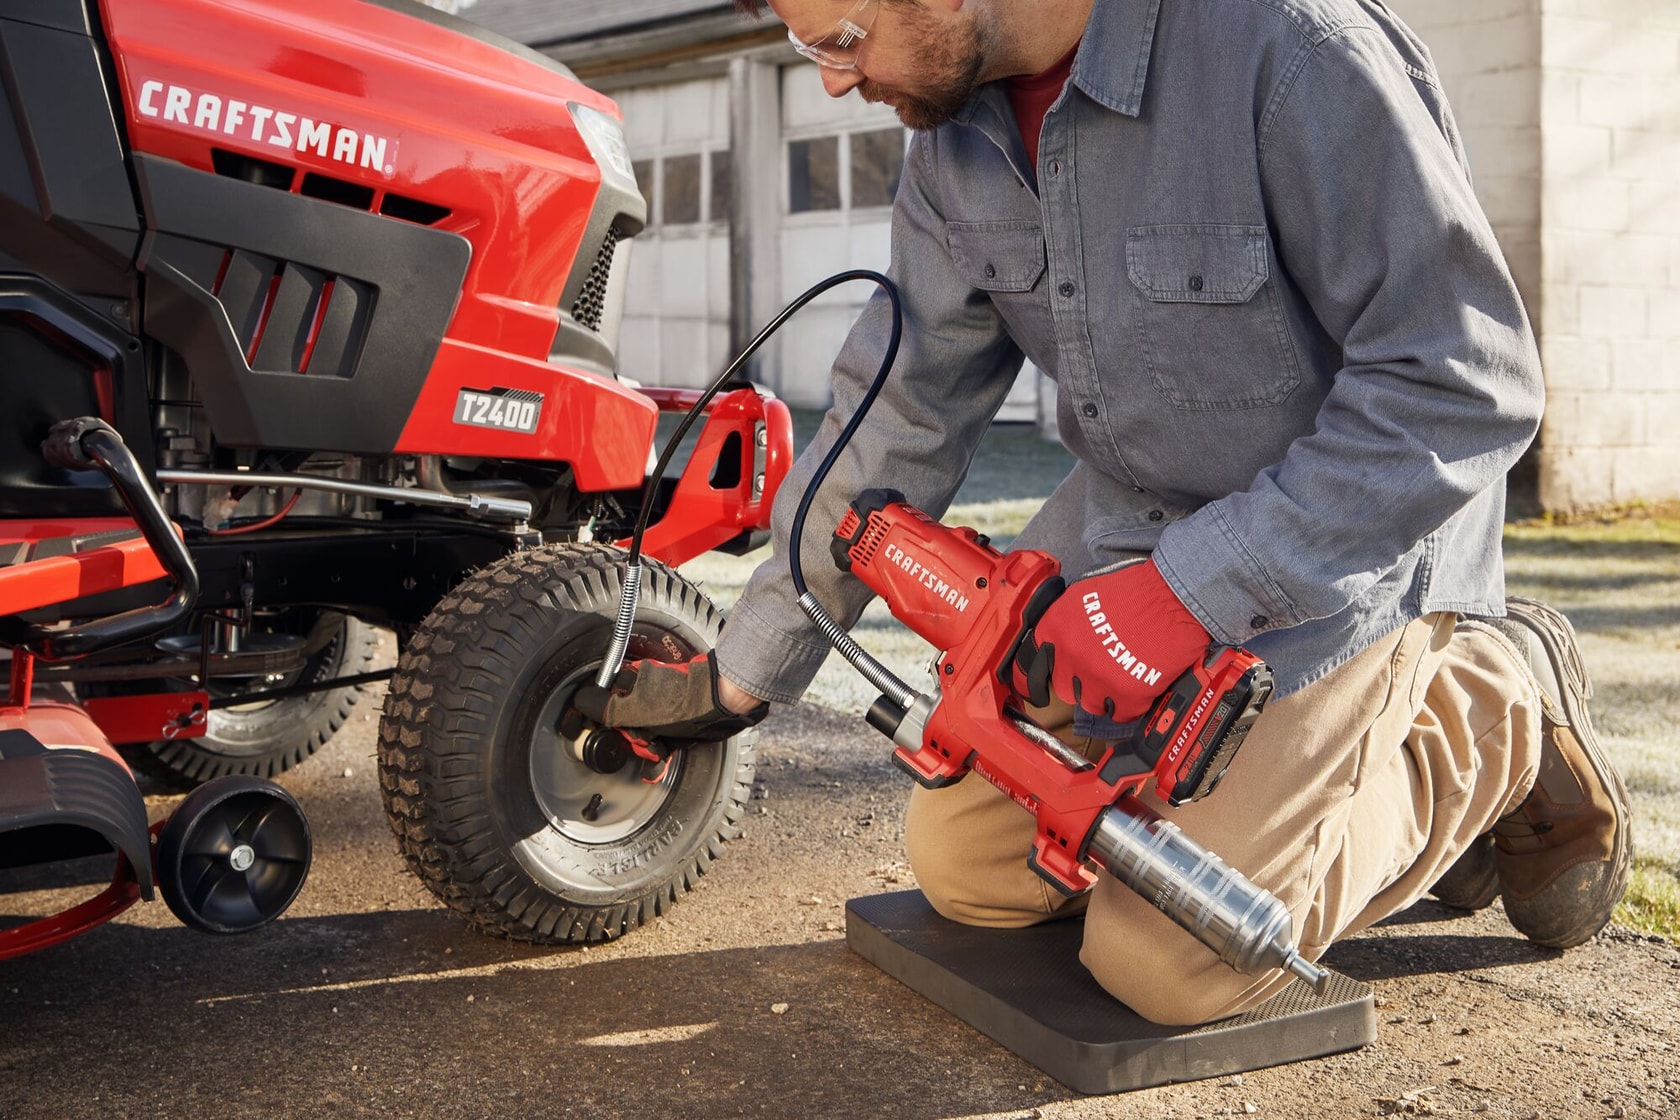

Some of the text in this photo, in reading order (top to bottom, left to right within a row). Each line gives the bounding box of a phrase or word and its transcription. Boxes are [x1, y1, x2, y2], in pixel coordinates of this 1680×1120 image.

[139, 80, 387, 172] CRAFTSMAN
[462, 394, 536, 430] T2400
[884, 543, 969, 613] CRAFTSMAN
[1082, 591, 1162, 687] CRAFTSMAN
[1168, 688, 1215, 762] CRAFTSMAN
